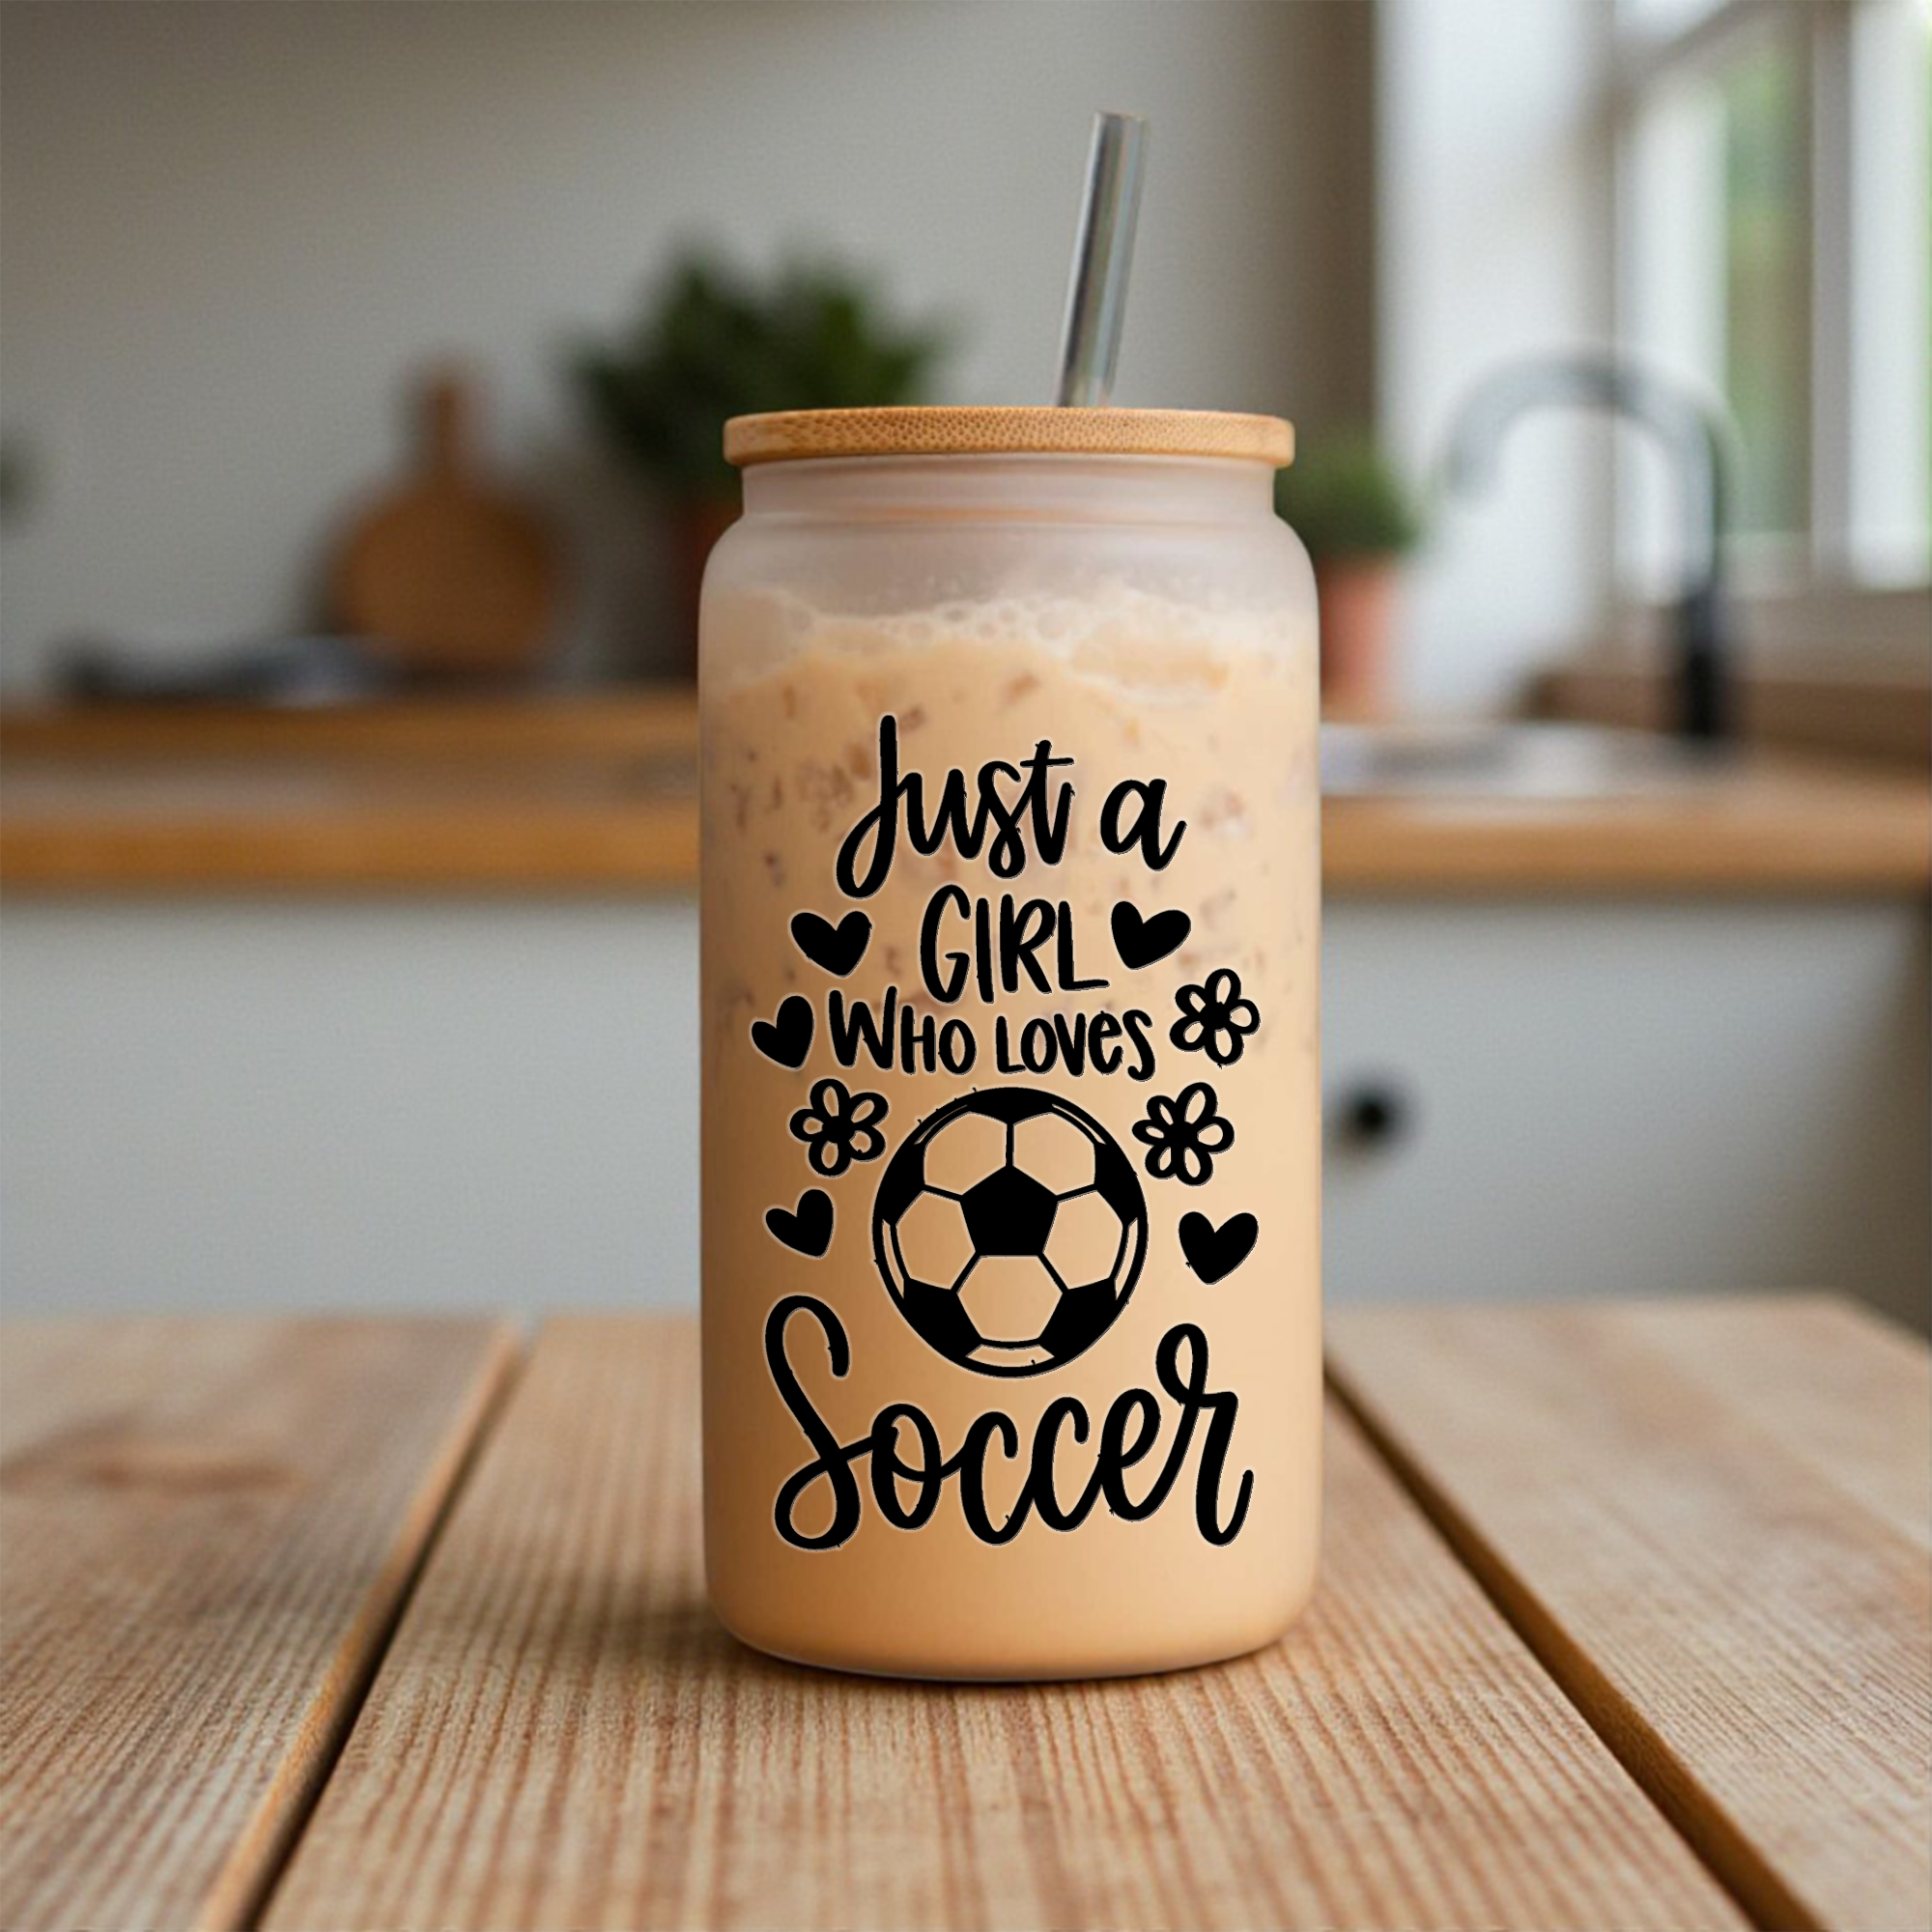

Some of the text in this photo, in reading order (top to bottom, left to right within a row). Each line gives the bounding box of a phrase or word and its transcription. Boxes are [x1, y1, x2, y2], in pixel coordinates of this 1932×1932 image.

[836, 715, 1187, 898] Just a
[920, 884, 1110, 1004] GIRL
[764, 1294, 1254, 1550] Soccer
